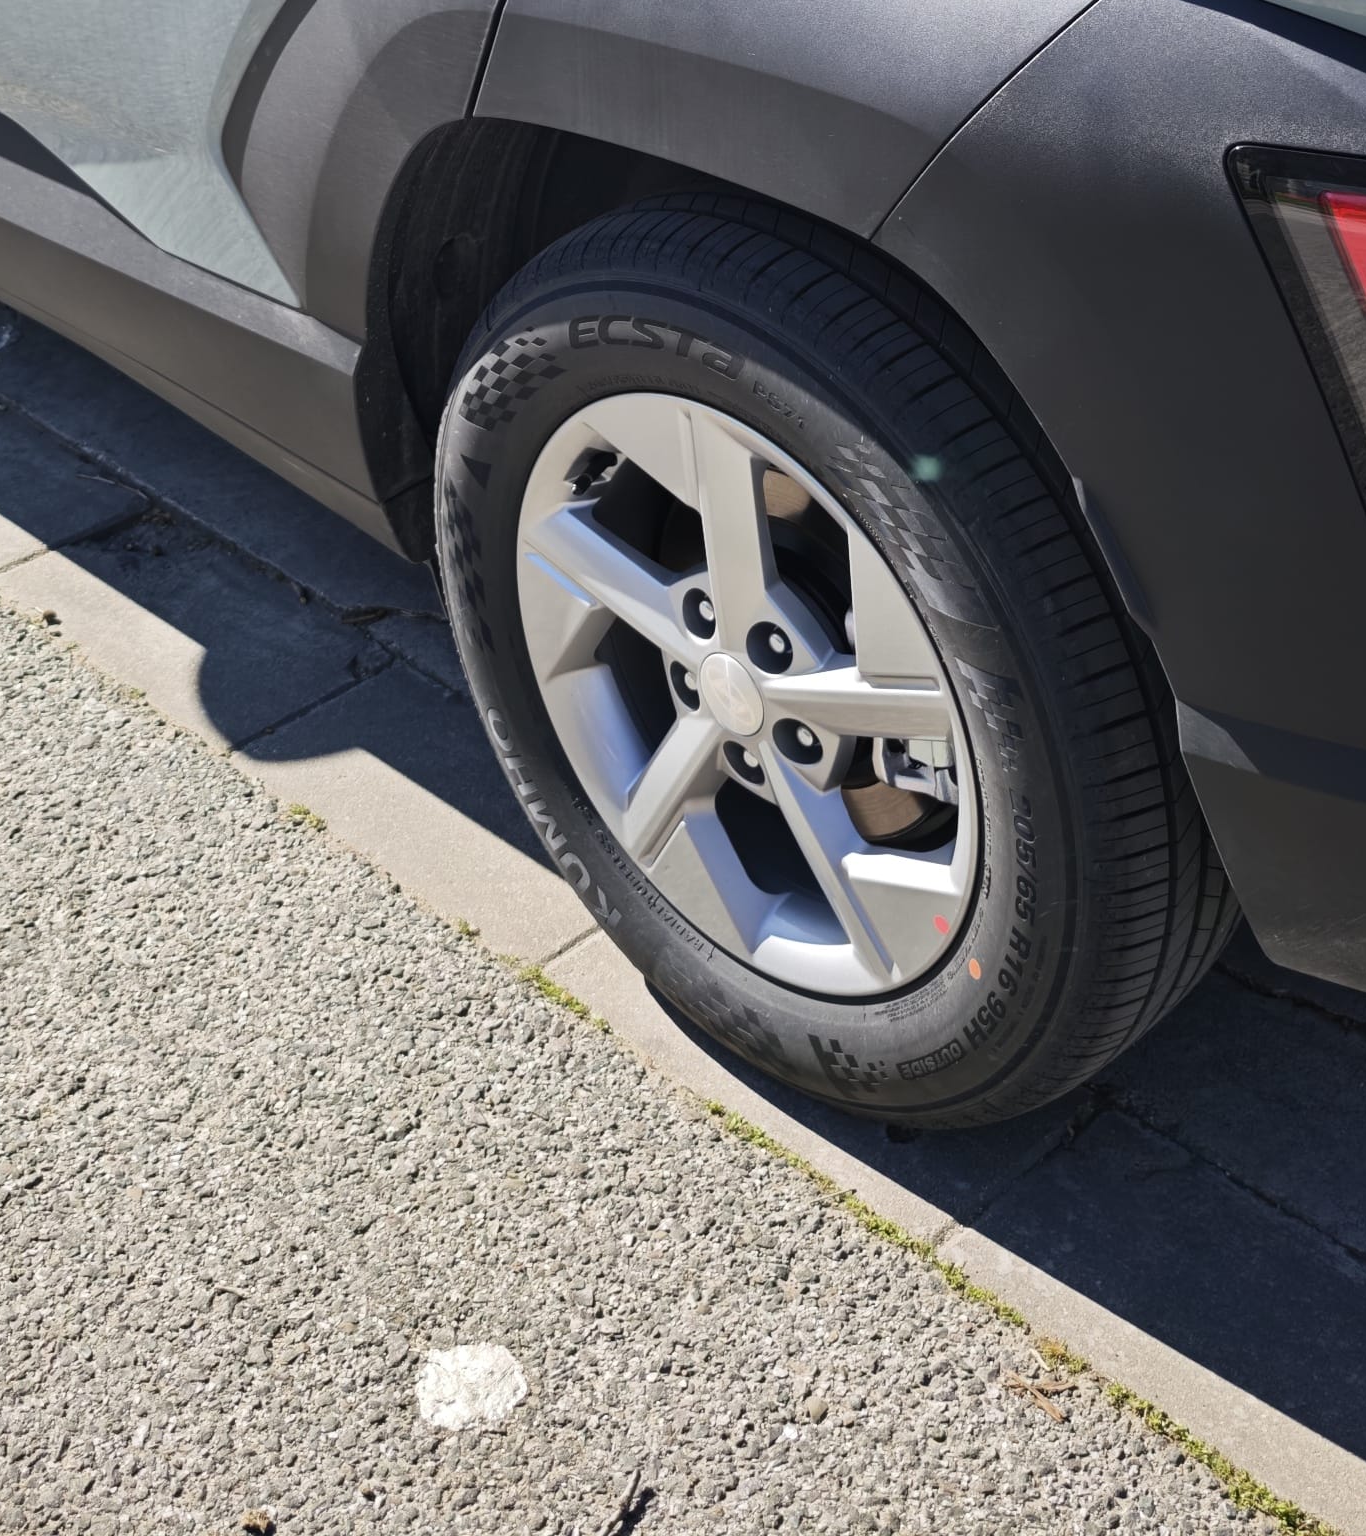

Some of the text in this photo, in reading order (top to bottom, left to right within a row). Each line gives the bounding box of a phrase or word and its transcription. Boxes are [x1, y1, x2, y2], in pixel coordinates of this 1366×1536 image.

[487, 707, 622, 929] KUMHO
[1009, 786, 1036, 926] 205/65
[997, 924, 1034, 999] R16
[962, 990, 1008, 1050] 95H
[898, 1036, 966, 1081] OUTSIDE
